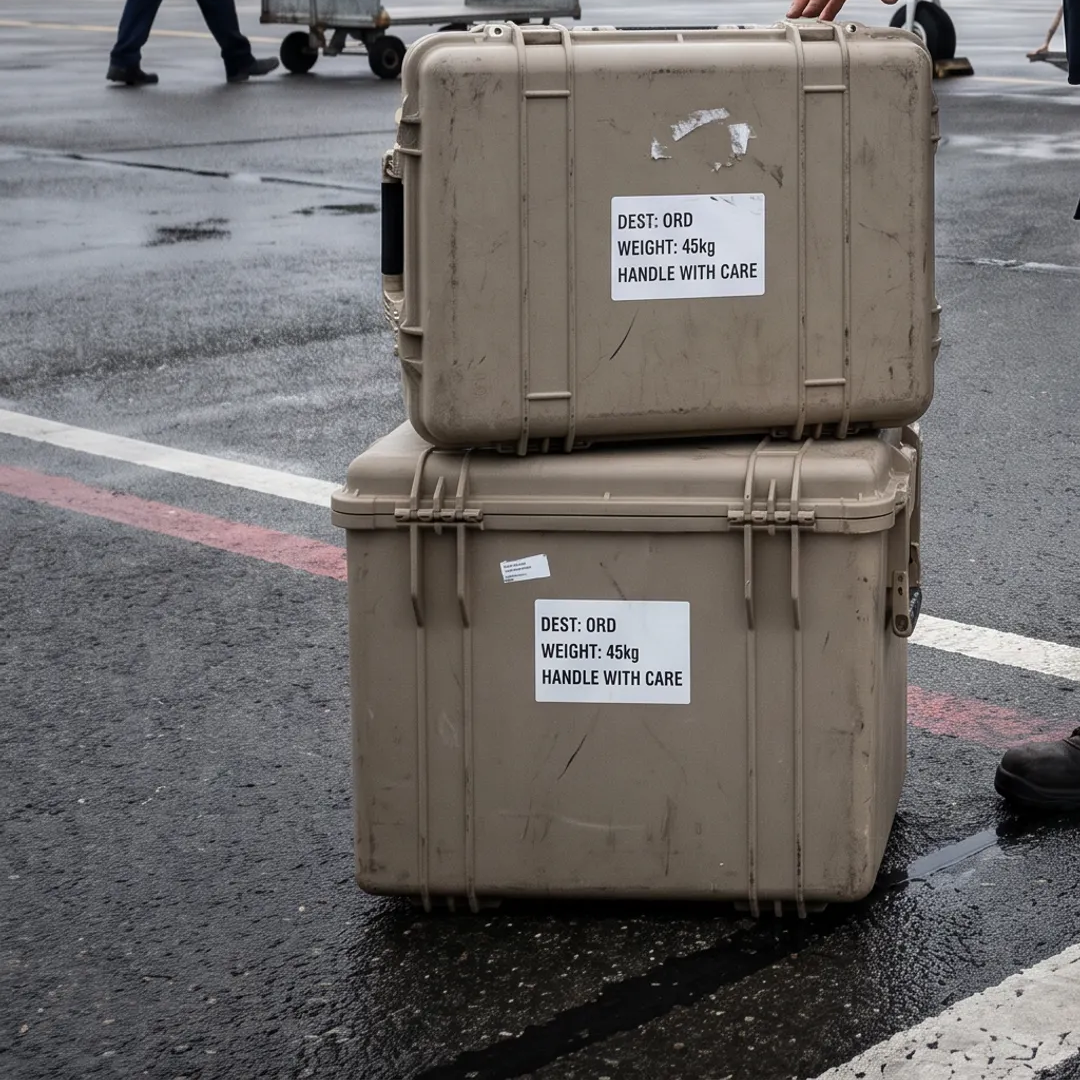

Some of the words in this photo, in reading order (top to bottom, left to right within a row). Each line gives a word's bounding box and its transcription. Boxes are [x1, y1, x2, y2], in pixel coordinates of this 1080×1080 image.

[619, 214, 658, 229] DEST:
[663, 213, 692, 228] ORD
[618, 239, 677, 256] WEIGHT:
[682, 238, 714, 257] 45kg
[619, 266, 674, 282] HANDLE
[680, 265, 715, 280] WITH
[721, 263, 757, 279] CARE
[542, 617, 581, 632] DEST:
[587, 618, 616, 632] ORD
[541, 644, 601, 659] WEIGHT:
[607, 645, 638, 663] 45kg
[543, 670, 599, 685] HANDLE
[604, 670, 640, 685] WITH
[646, 671, 682, 686] CARE
